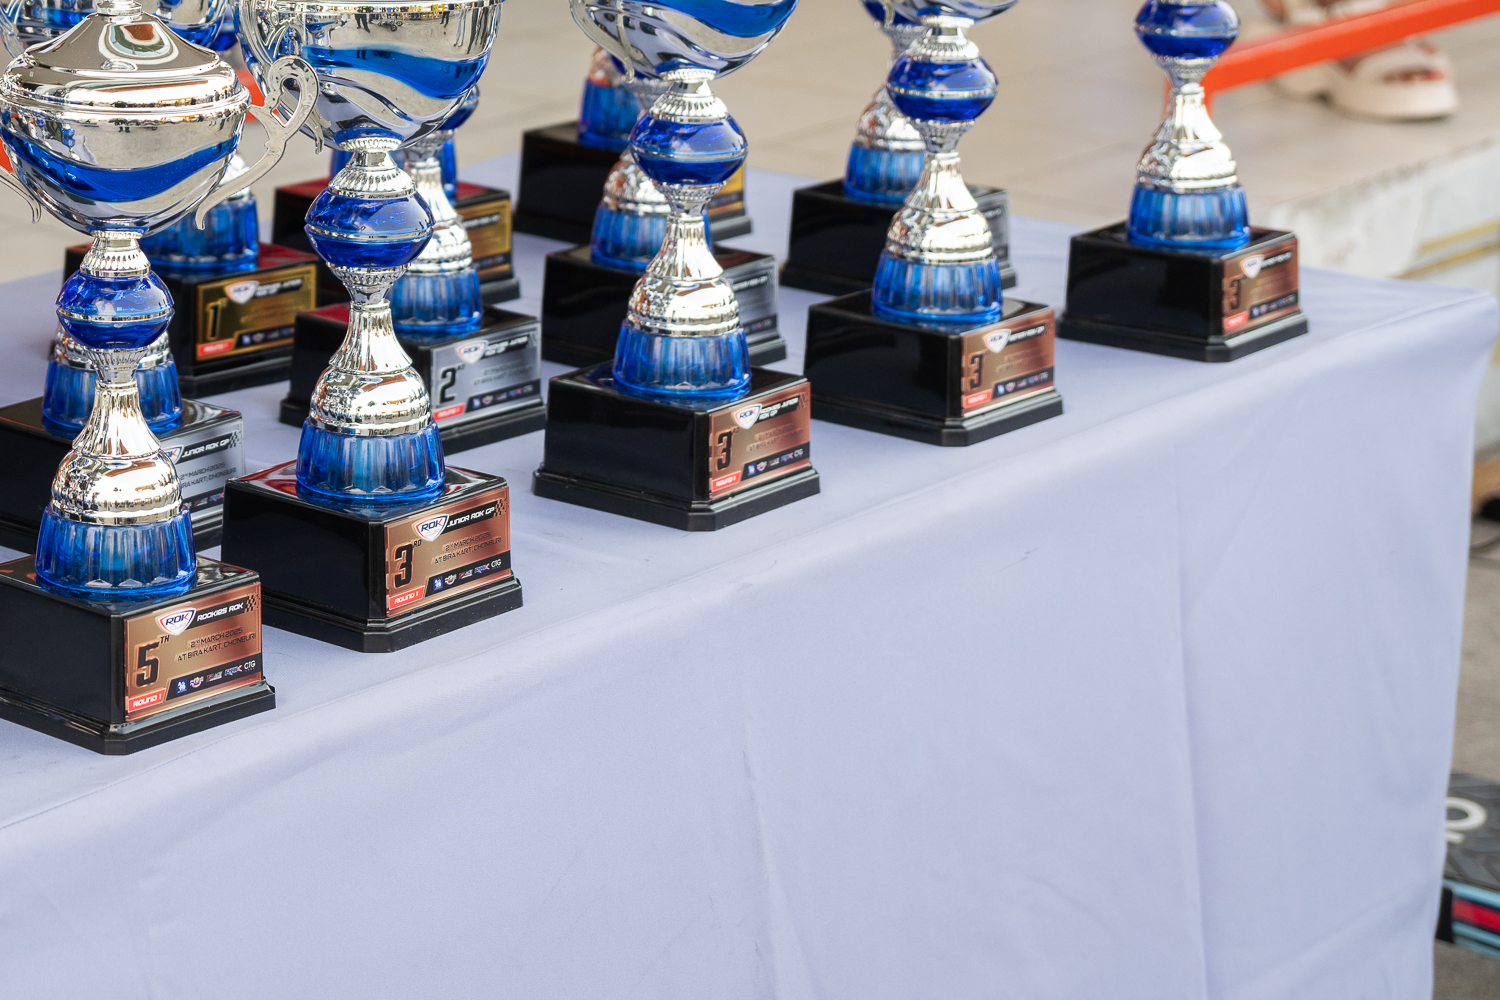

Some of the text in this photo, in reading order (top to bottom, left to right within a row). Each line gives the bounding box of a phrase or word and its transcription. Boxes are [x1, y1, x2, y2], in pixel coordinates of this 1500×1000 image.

[182, 446, 204, 457] JUNIOR
[205, 442, 219, 450] ROK
[421, 518, 443, 532] ROK
[447, 515, 470, 528] JUNIOR
[470, 510, 484, 520] ROK
[473, 537, 502, 552] CHONBURI
[394, 593, 415, 605] ROUND
[165, 613, 189, 625] ROK
[197, 602, 244, 621] ROOKIES ROK
[200, 632, 224, 645] MARCH
[225, 627, 243, 638] 2025
[177, 654, 187, 662] AT
[188, 649, 203, 659] BIRA
[224, 632, 256, 648] CHONBURI
[132, 695, 157, 707] ROUND
